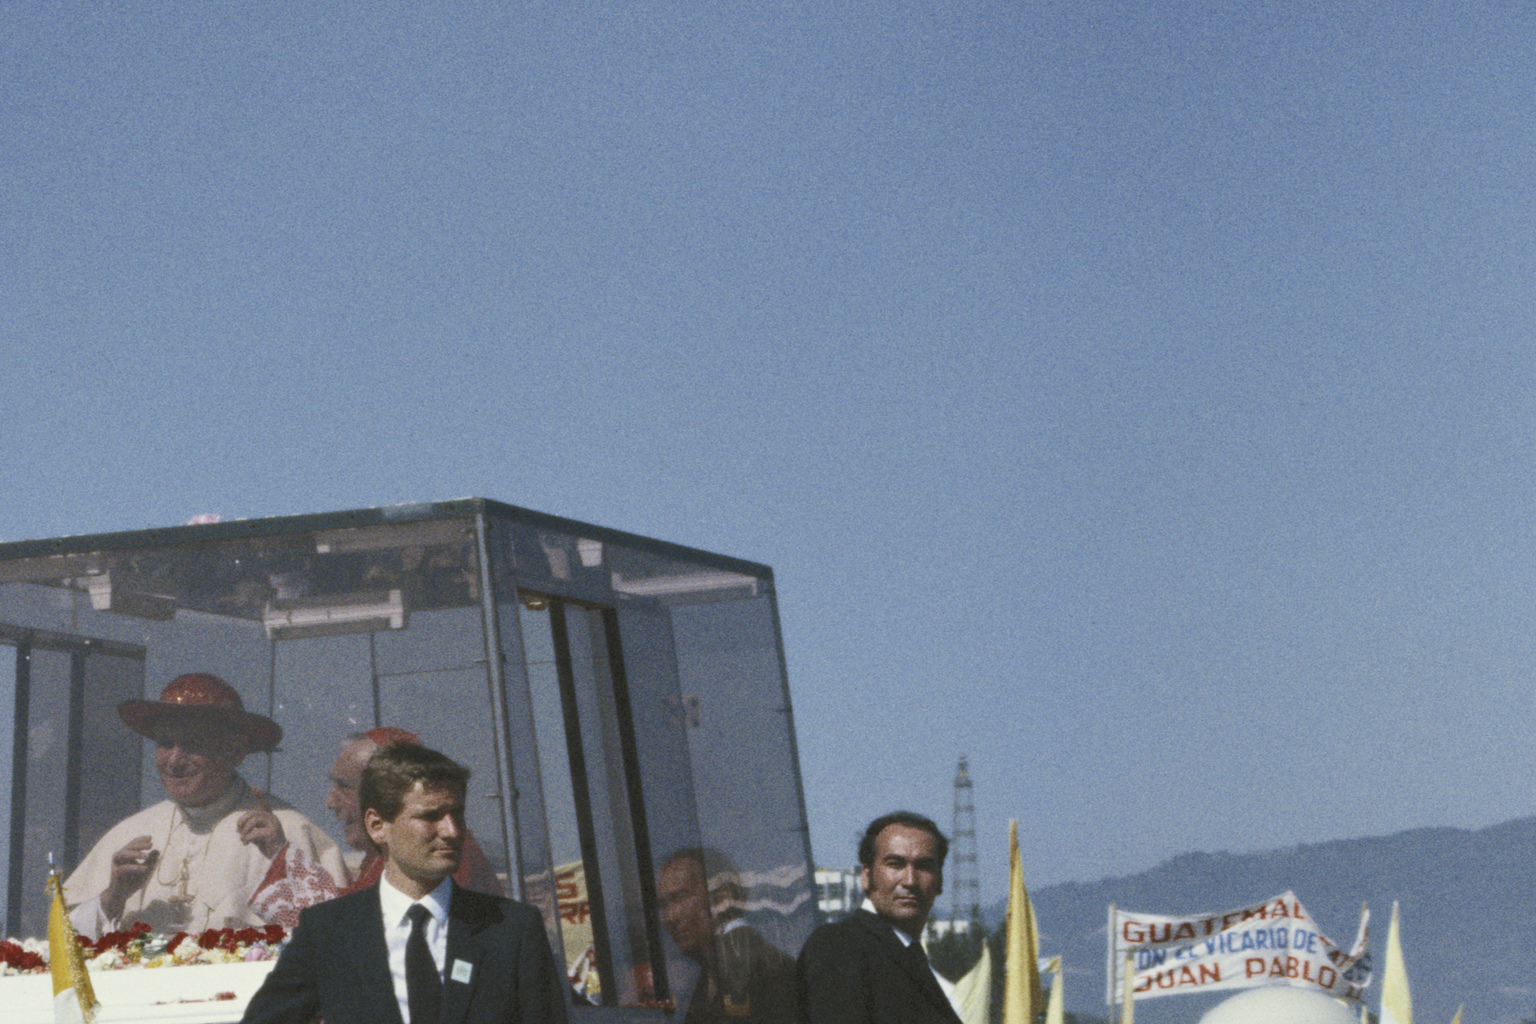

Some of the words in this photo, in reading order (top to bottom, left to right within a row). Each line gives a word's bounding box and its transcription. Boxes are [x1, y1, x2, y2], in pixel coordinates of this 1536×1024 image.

[1134, 948, 1167, 970] ON
[1205, 927, 1289, 956] VICARIO
[1293, 929, 1318, 955] DE
[1133, 962, 1222, 993] JUAN
[1245, 956, 1339, 989] PABLO
